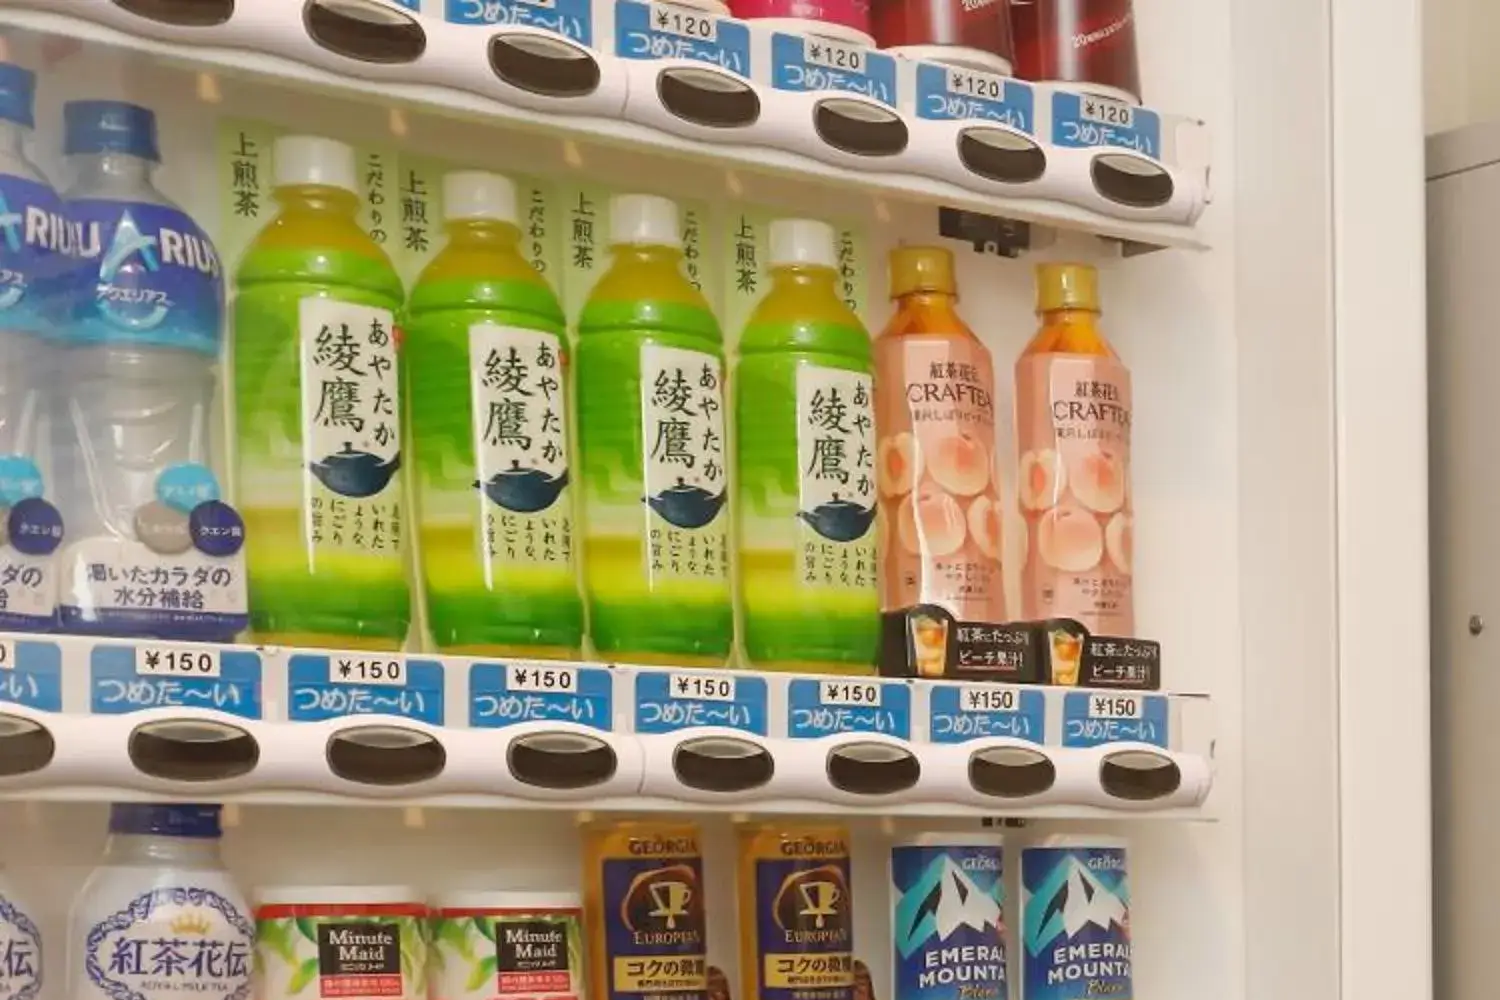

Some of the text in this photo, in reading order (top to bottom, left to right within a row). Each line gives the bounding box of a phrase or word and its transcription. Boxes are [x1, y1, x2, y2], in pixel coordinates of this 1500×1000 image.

[656, 9, 711, 37] ¥120
[810, 43, 860, 69] ¥120
[952, 74, 1000, 97] ¥120
[1085, 100, 1129, 124] ¥120
[232, 132, 260, 218] 上煎茶
[402, 169, 430, 252] 上煎茶
[571, 191, 594, 269] 上煎茶
[735, 214, 758, 296] 上煎茶
[312, 323, 368, 433] 綾鷹
[368, 317, 396, 448] あやたか
[481, 346, 537, 451] 綾鷹
[535, 341, 563, 465] あやたか
[906, 382, 994, 409] CRAFTEA
[650, 367, 699, 469] 綾鷹
[699, 362, 723, 483] あやたか
[807, 387, 855, 485] 綾鷹
[852, 379, 876, 497] あやたか
[88, 563, 231, 588] 渇いたカラダの
[113, 586, 204, 610] 水分補給
[144, 651, 214, 673] ¥150
[338, 659, 401, 681] ¥150
[514, 669, 572, 690] ¥150
[677, 678, 731, 698] ¥150
[827, 684, 878, 703] ¥150
[969, 689, 1013, 709] ¥150
[1095, 697, 1136, 717] ¥150
[329, 929, 393, 945] Minute
[505, 928, 563, 944] Minute
[108, 936, 250, 978] 紅茶花伝
[339, 945, 385, 961] Maid
[515, 943, 558, 959] Maid
